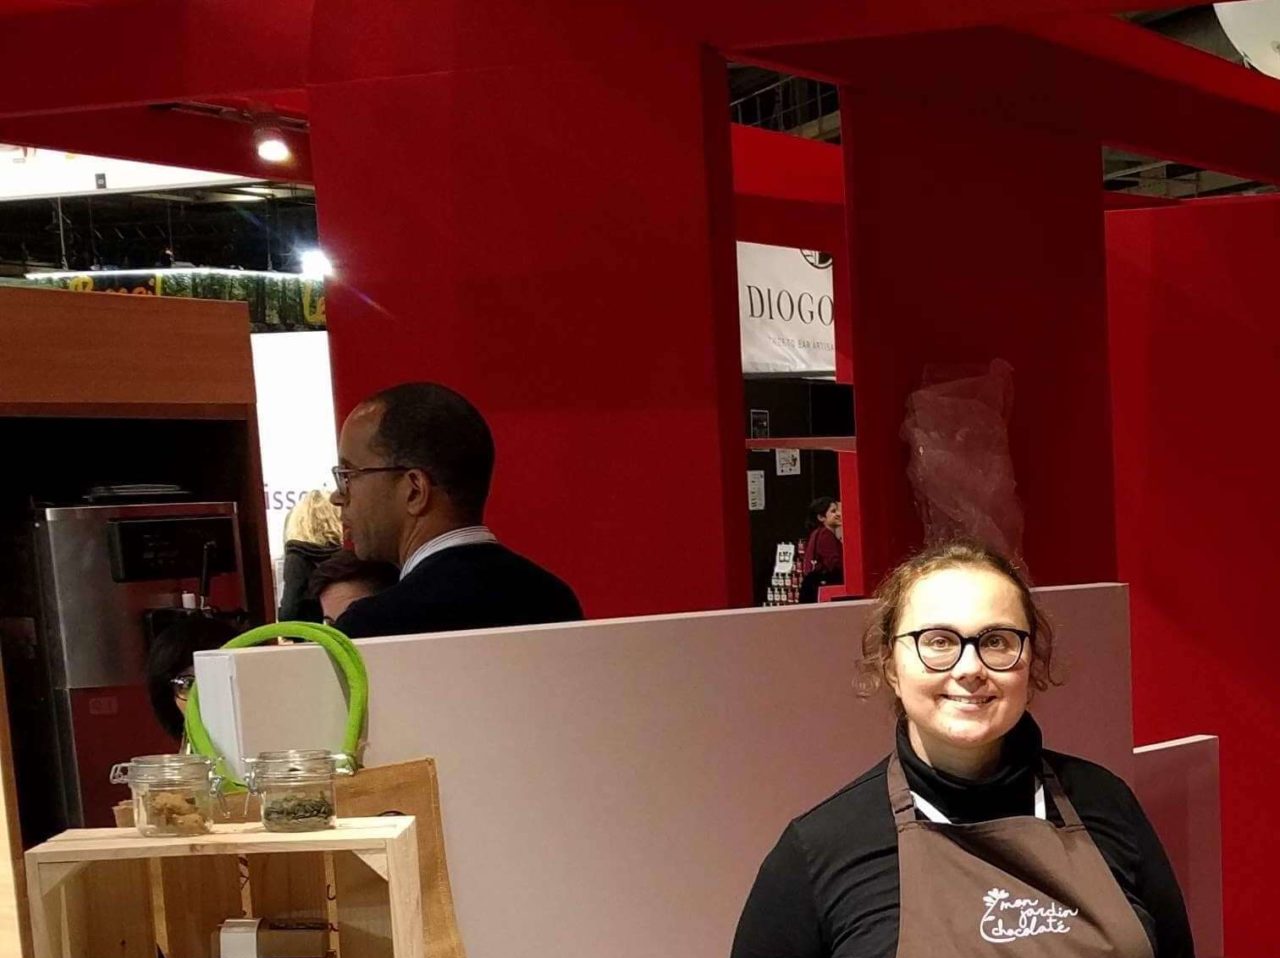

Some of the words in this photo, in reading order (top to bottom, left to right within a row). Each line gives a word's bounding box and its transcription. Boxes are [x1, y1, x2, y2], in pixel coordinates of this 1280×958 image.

[746, 284, 834, 327] DIOGO
[1000, 898, 1039, 911] mon
[1019, 903, 1079, 928] jardin
[991, 916, 1071, 938] chocolaté
